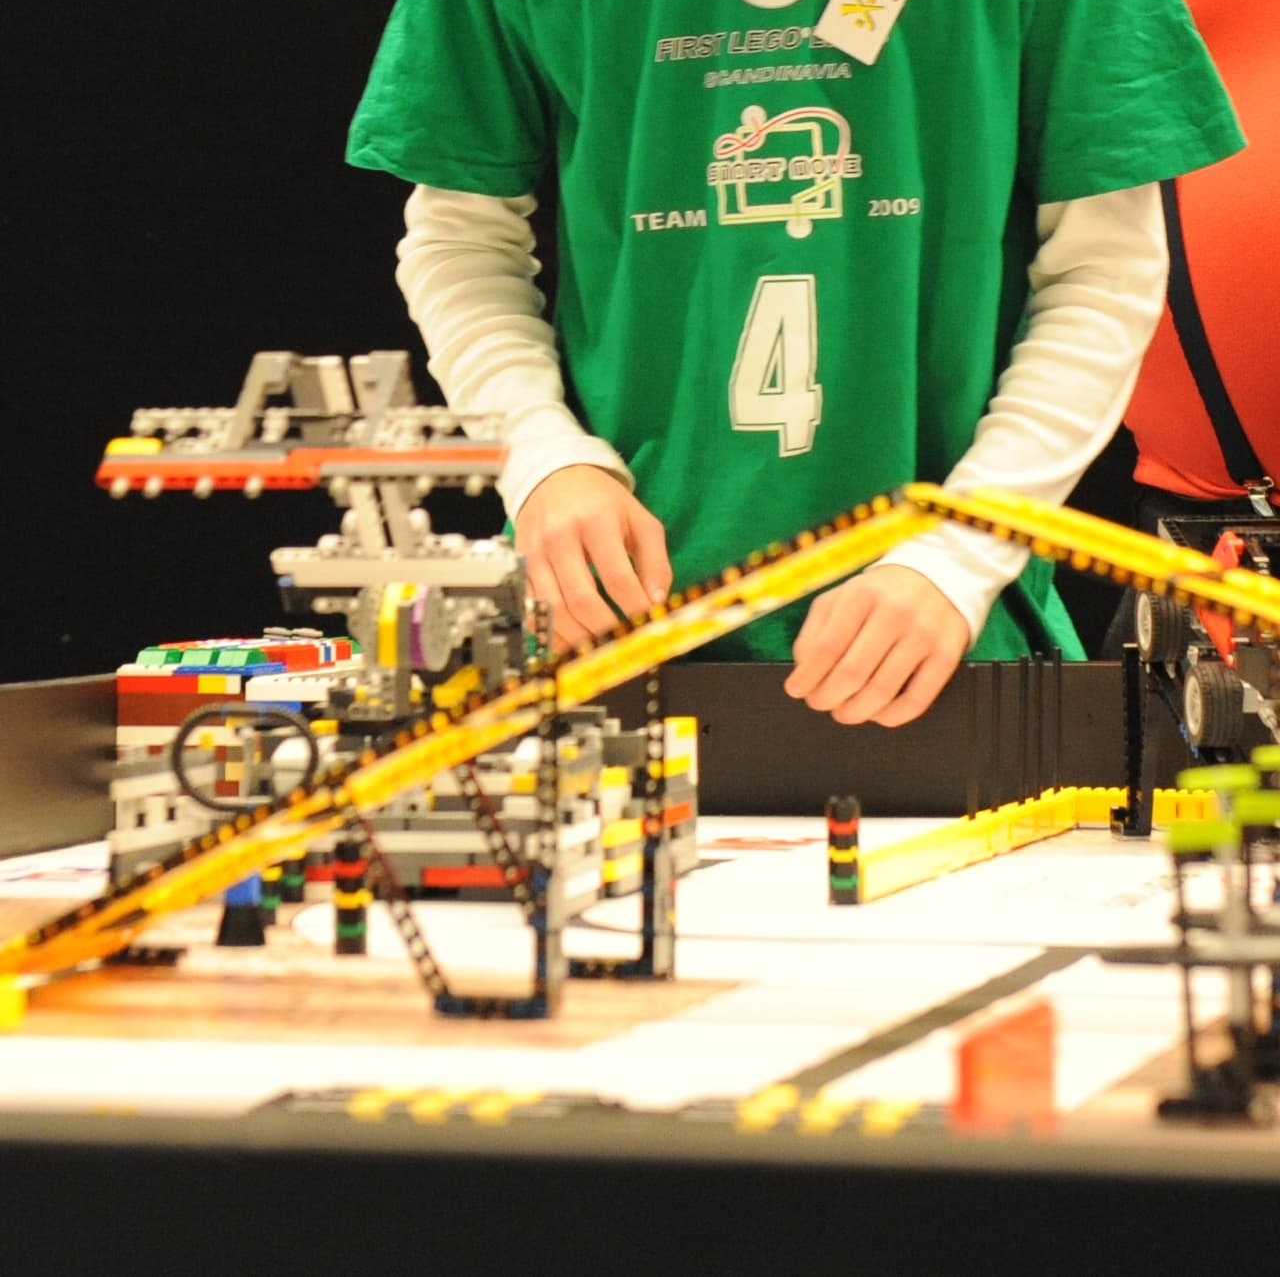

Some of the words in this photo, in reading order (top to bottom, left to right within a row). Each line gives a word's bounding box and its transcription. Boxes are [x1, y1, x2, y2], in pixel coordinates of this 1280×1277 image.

[654, 33, 726, 63] FIRST
[704, 62, 853, 88] SCANDINAVIA
[867, 197, 921, 217] 2009
[630, 209, 708, 232] TEAM
[727, 274, 824, 458] 4
